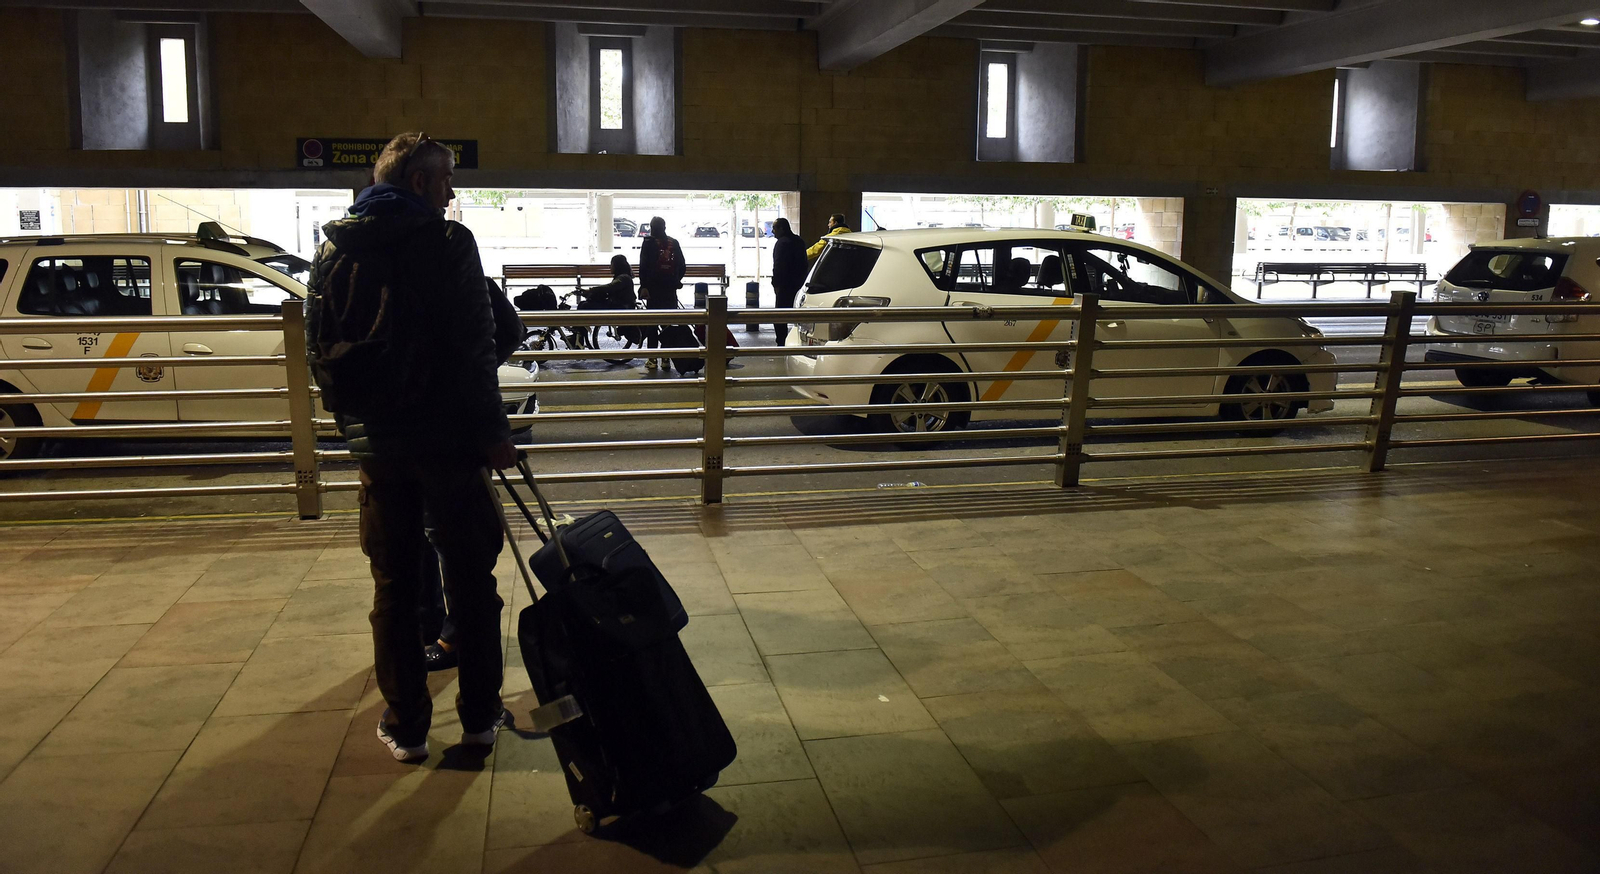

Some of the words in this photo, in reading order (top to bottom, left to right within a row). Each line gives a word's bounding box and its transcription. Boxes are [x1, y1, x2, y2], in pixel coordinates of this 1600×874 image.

[332, 143, 376, 151] PROHIBIDO
[332, 151, 367, 164] Zona
[370, 151, 378, 164] d
[1477, 322, 1492, 333] SP
[77, 337, 98, 346] 1531
[84, 346, 91, 355] F
